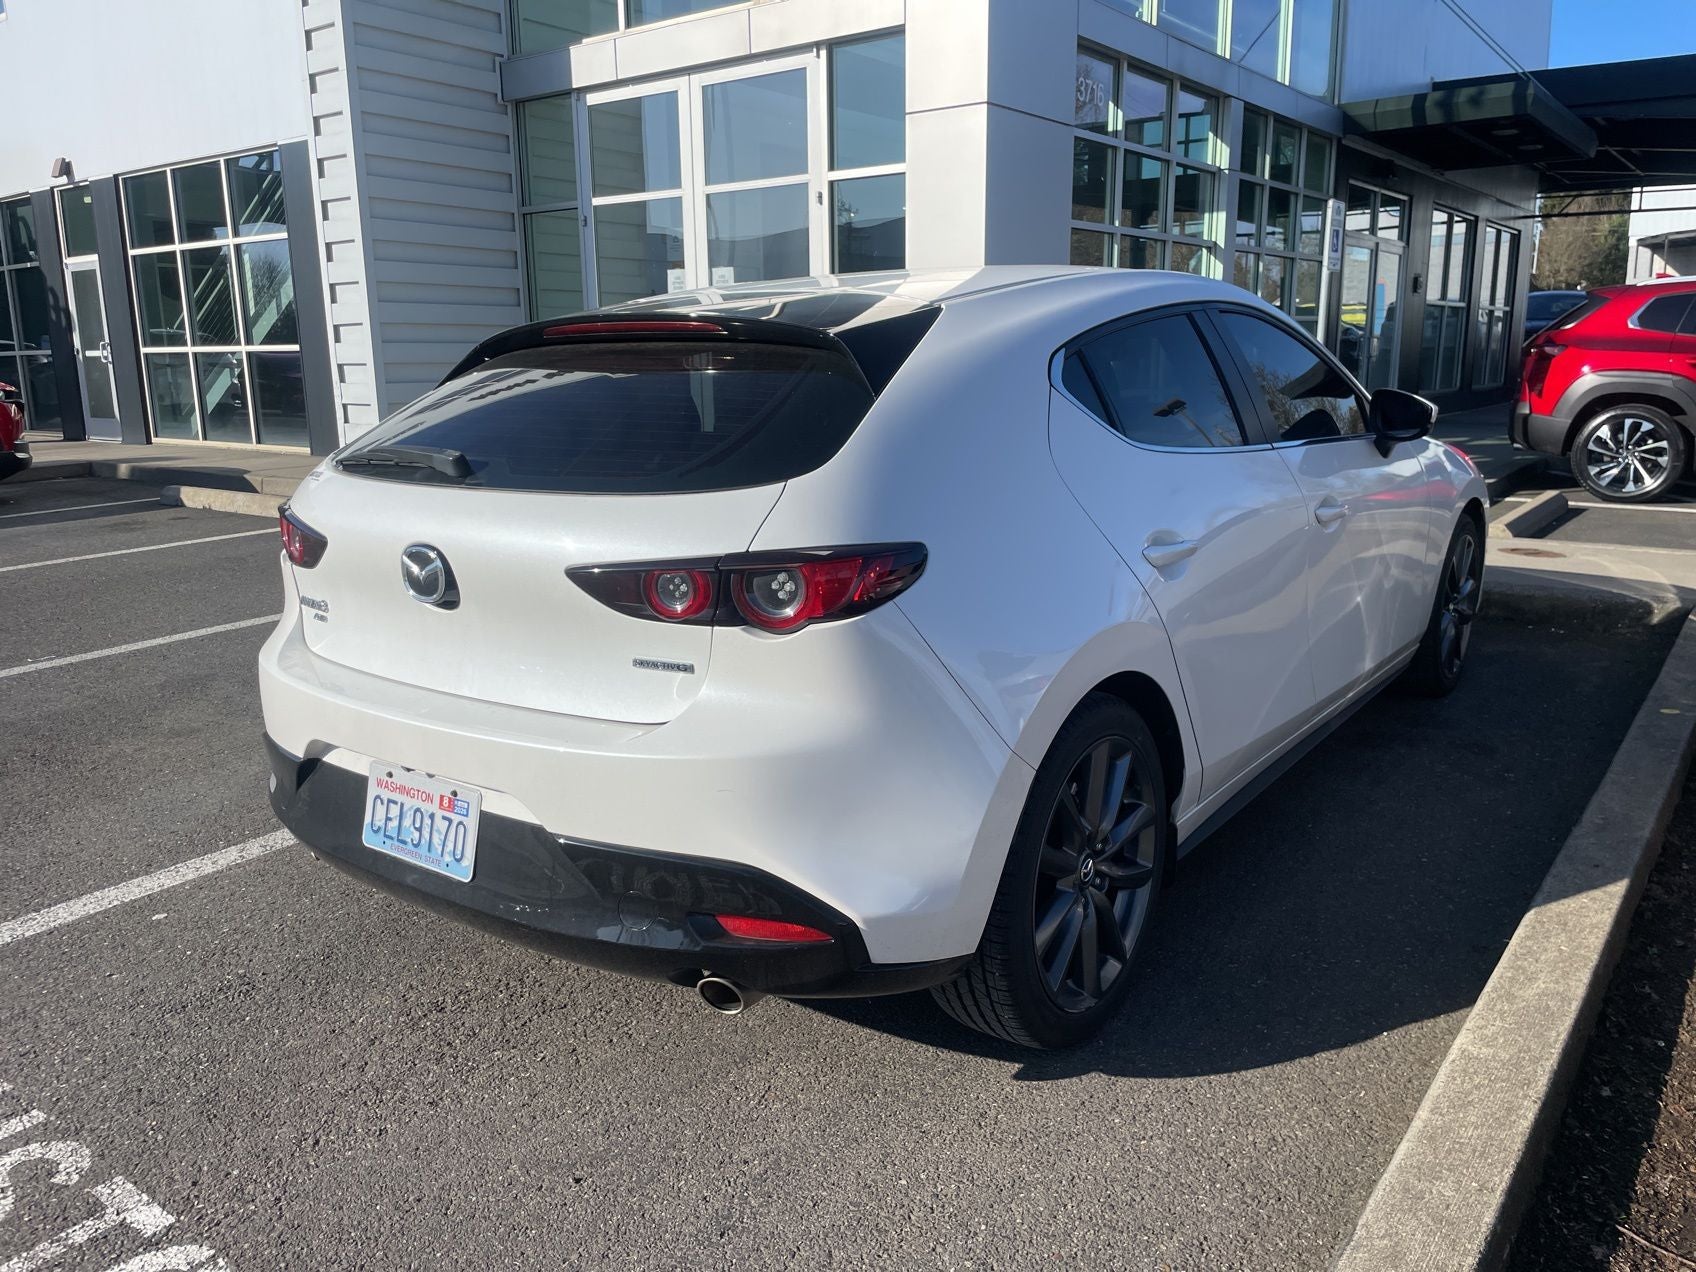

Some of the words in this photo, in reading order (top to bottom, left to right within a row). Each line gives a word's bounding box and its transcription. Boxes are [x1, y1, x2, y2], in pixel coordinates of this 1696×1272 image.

[1077, 78, 1104, 106] 3716
[376, 777, 434, 804] WASHINGTON
[443, 796, 449, 807] 8
[370, 794, 467, 863] CEL9170
[389, 844, 422, 861] EVERGREEN
[424, 855, 442, 868] STATE
